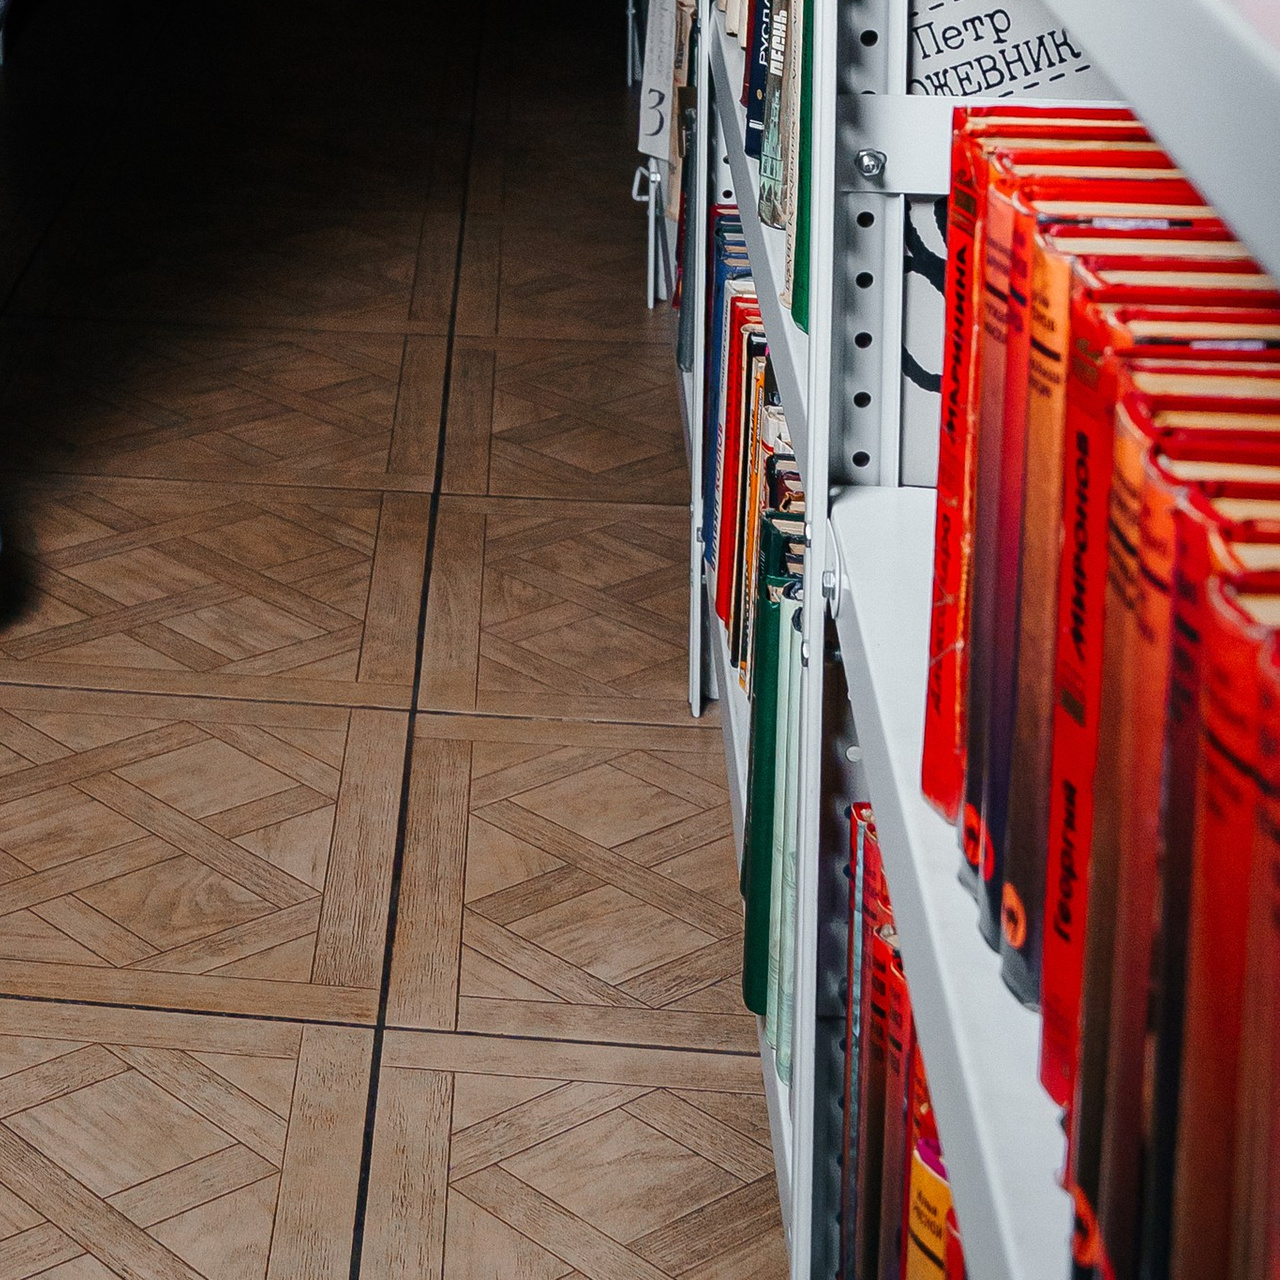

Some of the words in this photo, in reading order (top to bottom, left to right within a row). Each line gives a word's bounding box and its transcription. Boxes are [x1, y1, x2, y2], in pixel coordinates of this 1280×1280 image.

[769, 9, 788, 77] ПЕСНЬ
[911, 8, 1012, 60] Петр
[644, 88, 666, 137] 3
[946, 244, 968, 444] МАРИНИНА
[714, 422, 724, 493] КОЗЛОВ
[1072, 430, 1090, 664] МИРОНОВ
[1054, 777, 1078, 943] Георгий
